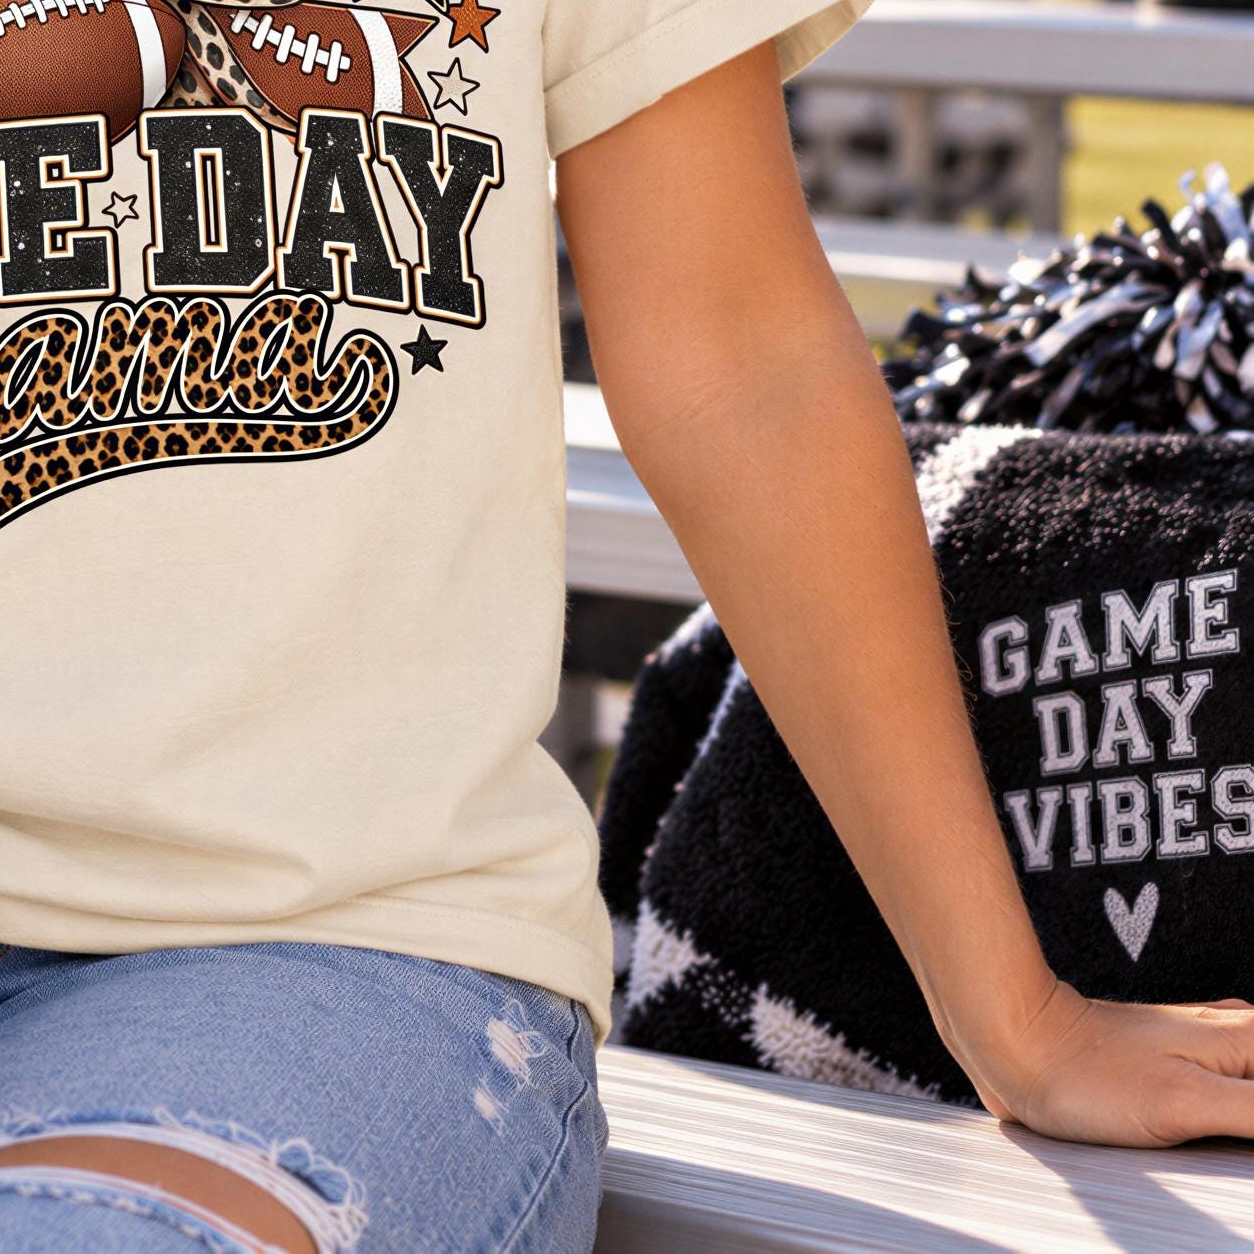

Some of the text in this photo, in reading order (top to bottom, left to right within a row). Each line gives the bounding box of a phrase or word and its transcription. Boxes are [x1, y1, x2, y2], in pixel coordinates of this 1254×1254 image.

[137, 107, 503, 329] DAY
[978, 568, 1241, 699] GAME
[1032, 669, 1213, 777] DAY
[1004, 764, 1254, 872] VIBES
